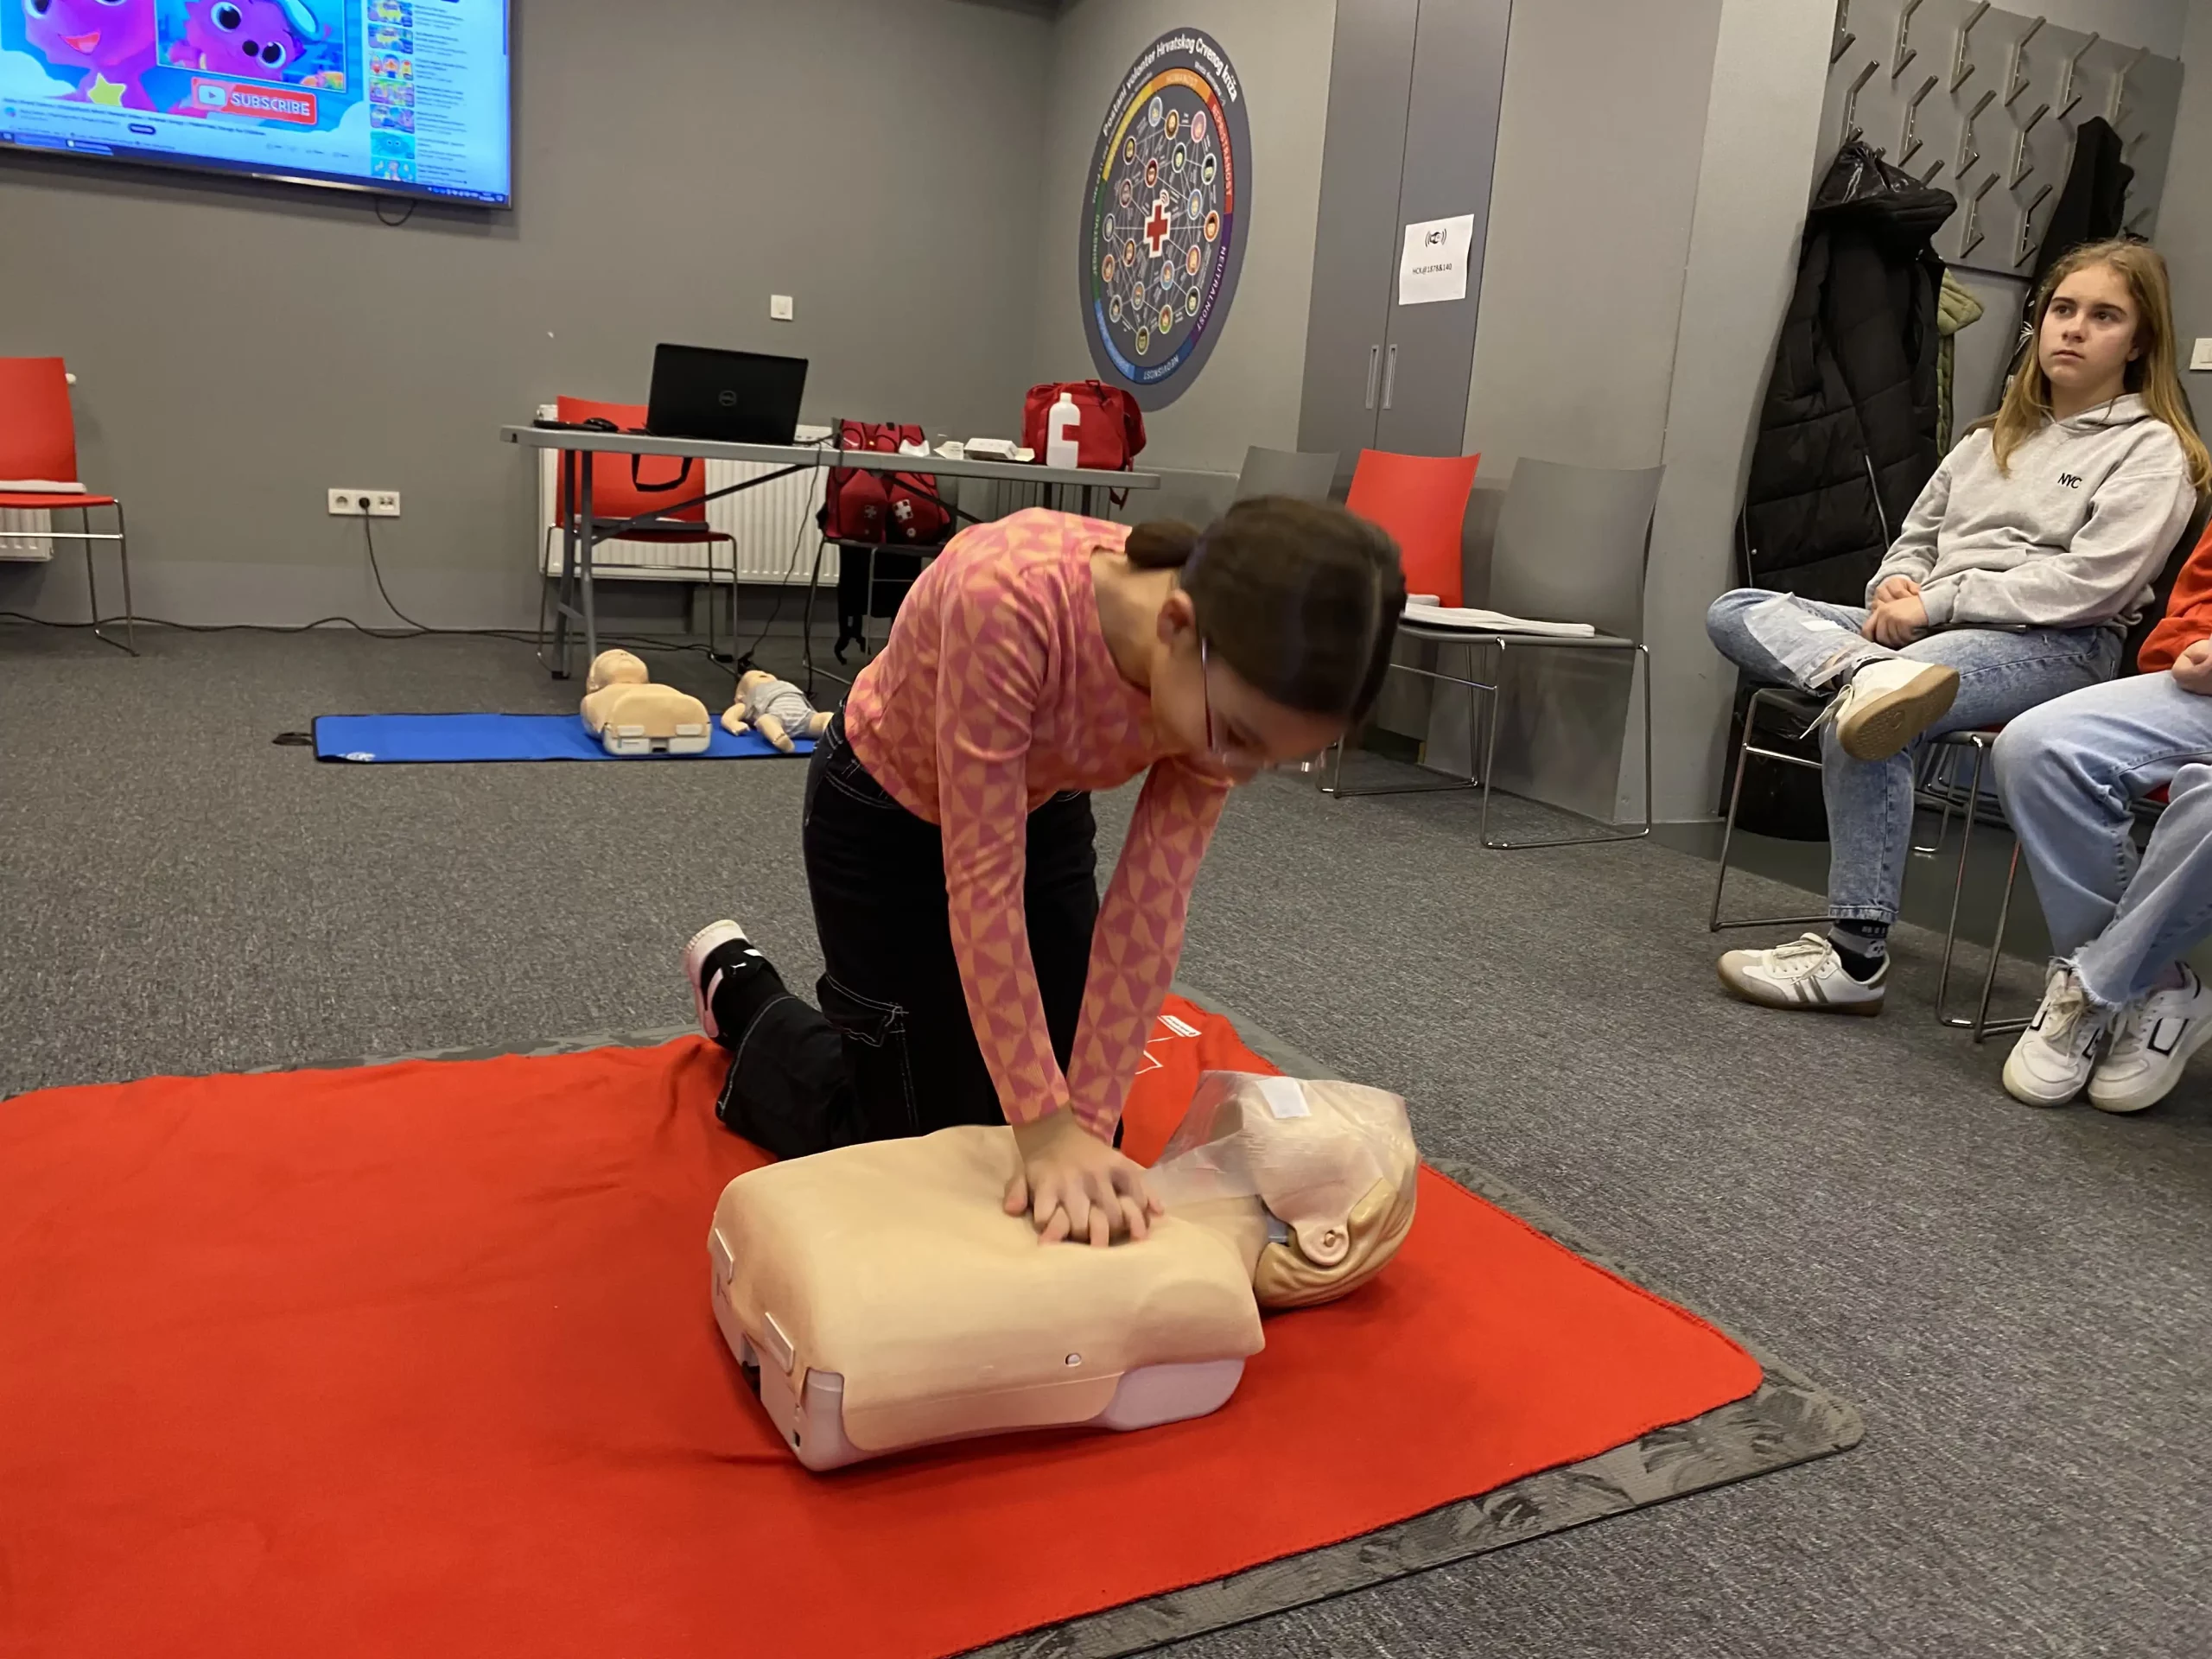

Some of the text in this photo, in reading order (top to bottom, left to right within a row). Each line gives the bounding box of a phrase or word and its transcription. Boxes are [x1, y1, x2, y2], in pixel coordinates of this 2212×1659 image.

[231, 92, 311, 117] SUBSCRIBE
[1103, 84, 1128, 137] Postani
[1127, 51, 1156, 88] volonter
[1156, 34, 1196, 59] Hrvatskog
[1196, 38, 1224, 77] Crvenog
[1197, 246, 1226, 332] NEUTRALNOST
[2057, 473, 2083, 489] NYC
